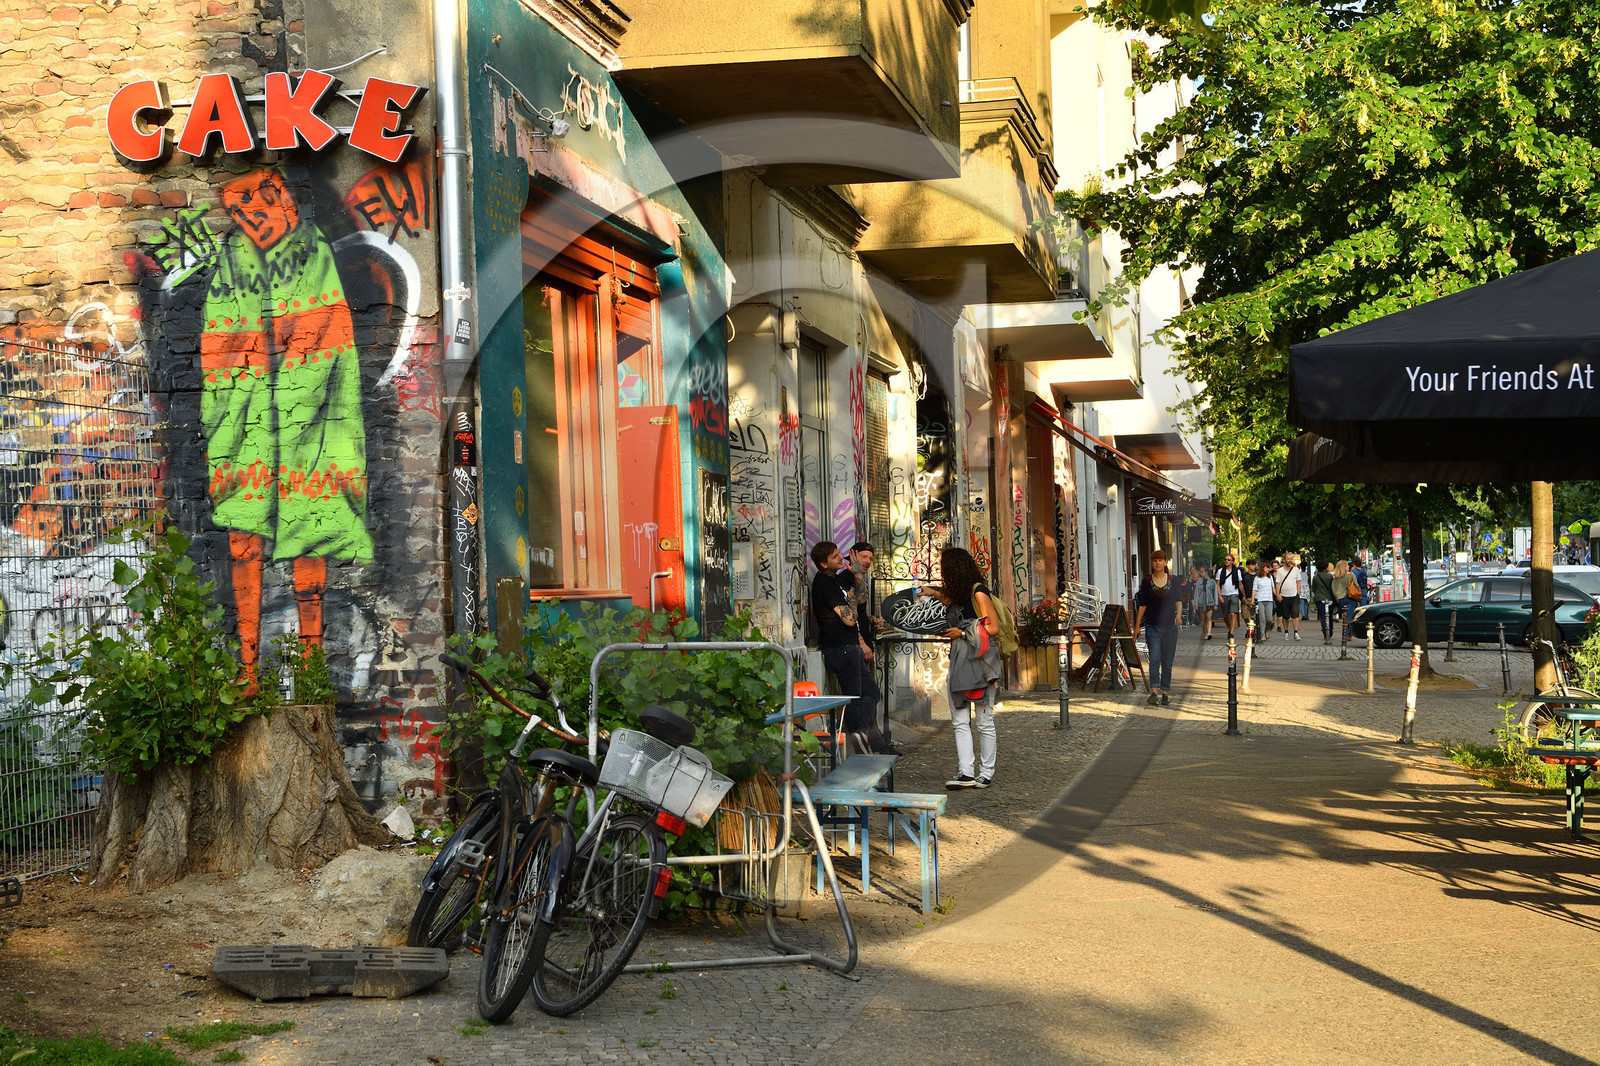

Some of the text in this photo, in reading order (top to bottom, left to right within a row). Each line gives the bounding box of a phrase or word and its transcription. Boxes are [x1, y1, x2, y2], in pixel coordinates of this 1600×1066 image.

[106, 68, 424, 163] CAKE
[1405, 363, 1595, 392] Your Friends At
[892, 598, 947, 628] Tatto
